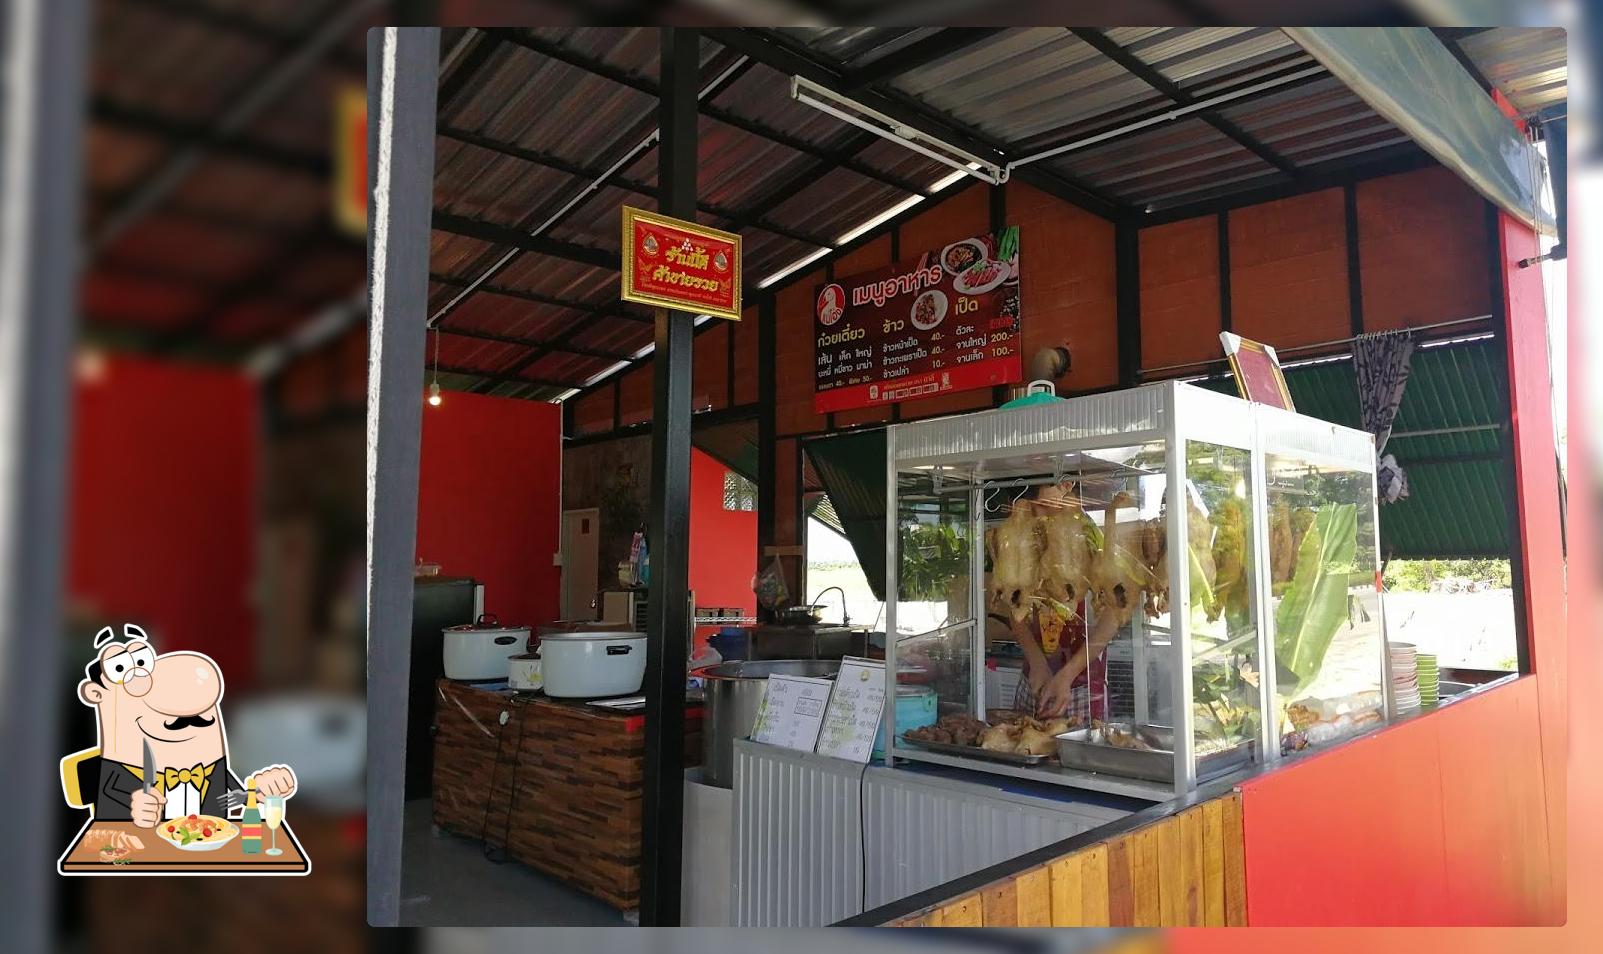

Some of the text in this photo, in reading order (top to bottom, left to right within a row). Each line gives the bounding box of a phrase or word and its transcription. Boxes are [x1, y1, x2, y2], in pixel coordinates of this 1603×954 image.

[852, 264, 944, 308] เมนูอาหาร
[955, 296, 979, 316] เป็ด
[882, 319, 905, 334] ข้าว
[955, 325, 975, 336] ตัวละ
[882, 332, 945, 353] ข้าวหน้าเป็ด 40.-
[956, 332, 1014, 350] จานใหญ่ 200.-
[818, 353, 833, 366] เส้น
[855, 345, 872, 358] ใหญ่
[931, 346, 945, 355] 40.-
[956, 346, 1014, 364] จานเล็ก 100.-
[856, 359, 873, 371] มาม่า
[882, 360, 946, 379] ข้าวเปล่า 10.-
